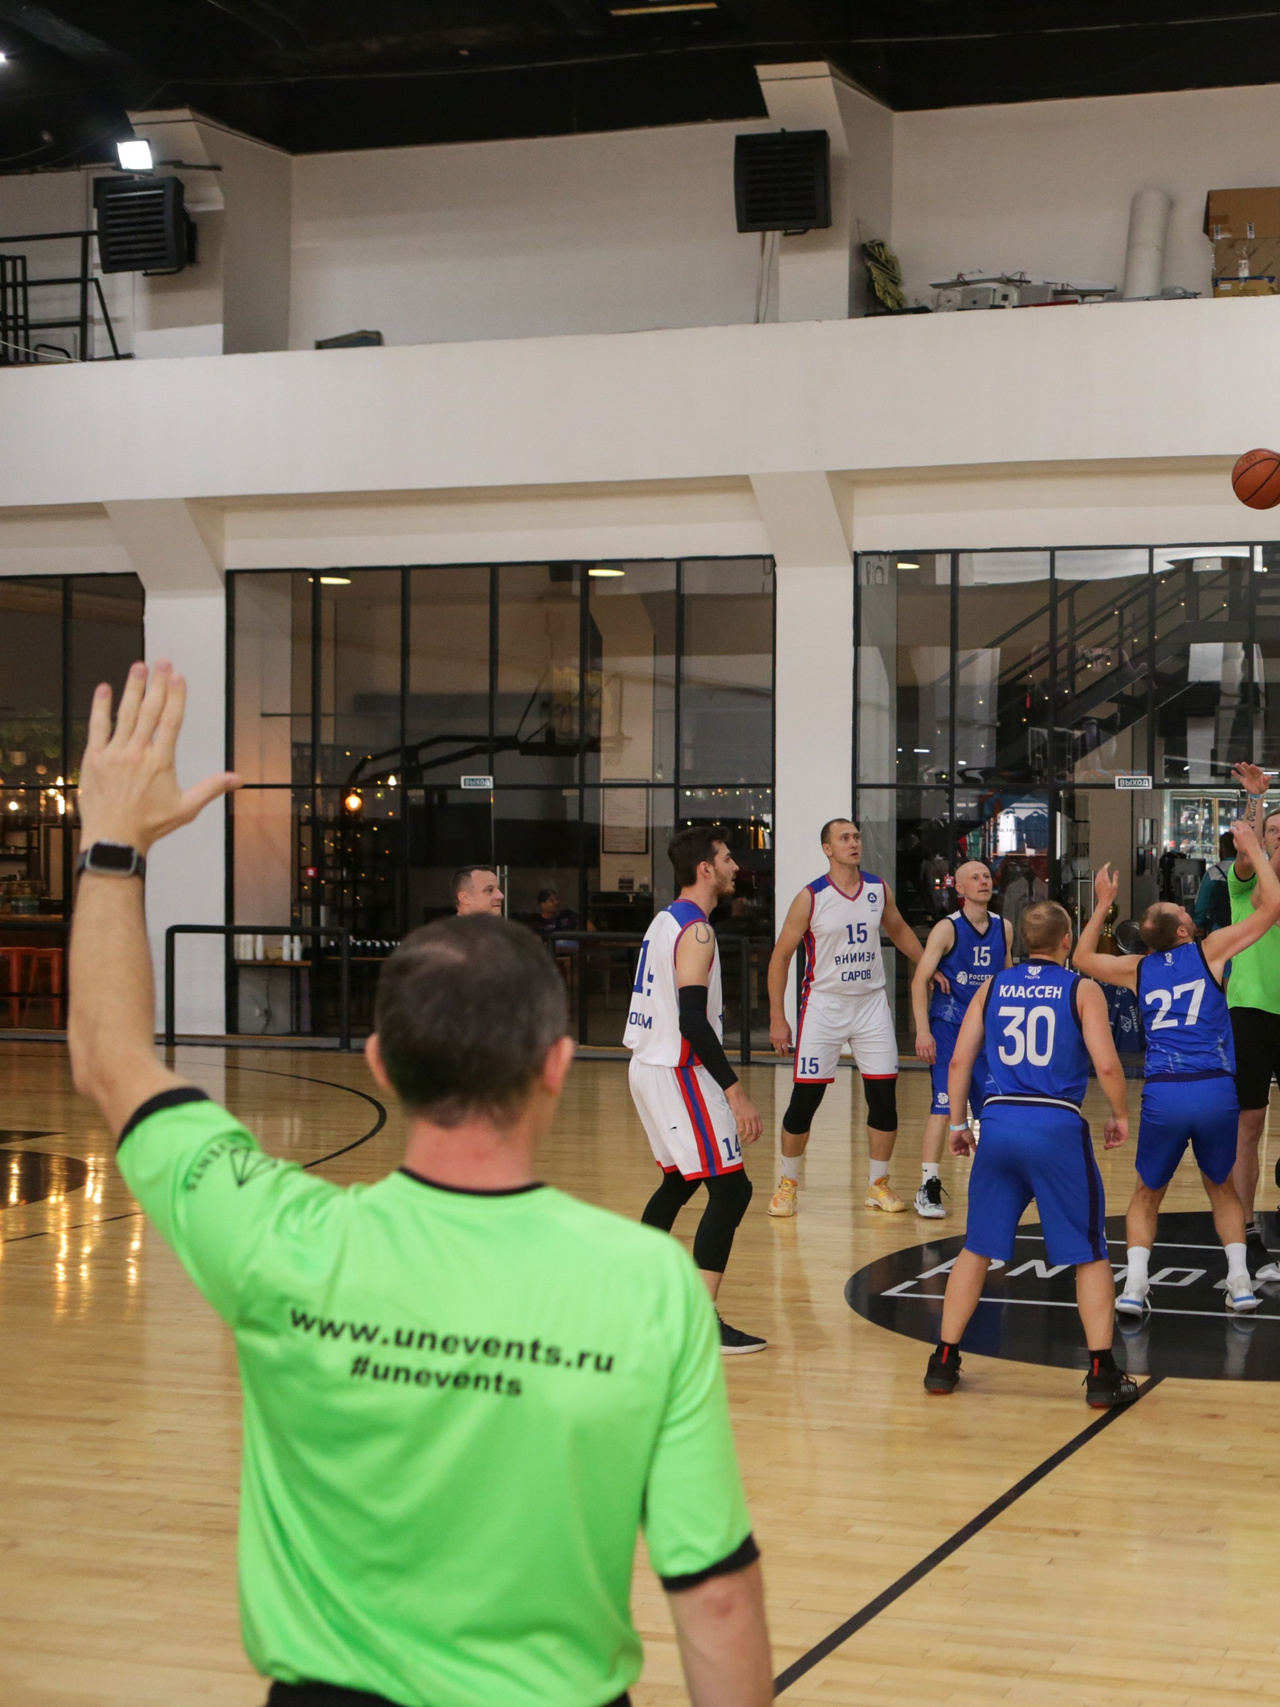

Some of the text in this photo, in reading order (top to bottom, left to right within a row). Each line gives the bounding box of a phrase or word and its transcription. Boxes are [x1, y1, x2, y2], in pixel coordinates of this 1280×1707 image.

[846, 922, 868, 945] 15
[973, 946, 991, 967] 15
[841, 969, 871, 982] САРОВ
[999, 984, 1063, 999] КЛАССЕН
[1145, 978, 1206, 1031] 27
[998, 1005, 1056, 1067] 30
[800, 1056, 819, 1075] 15
[722, 1134, 741, 1161] 14
[290, 1308, 615, 1373] www.unevents.ru
[350, 1354, 522, 1397] #unevents
